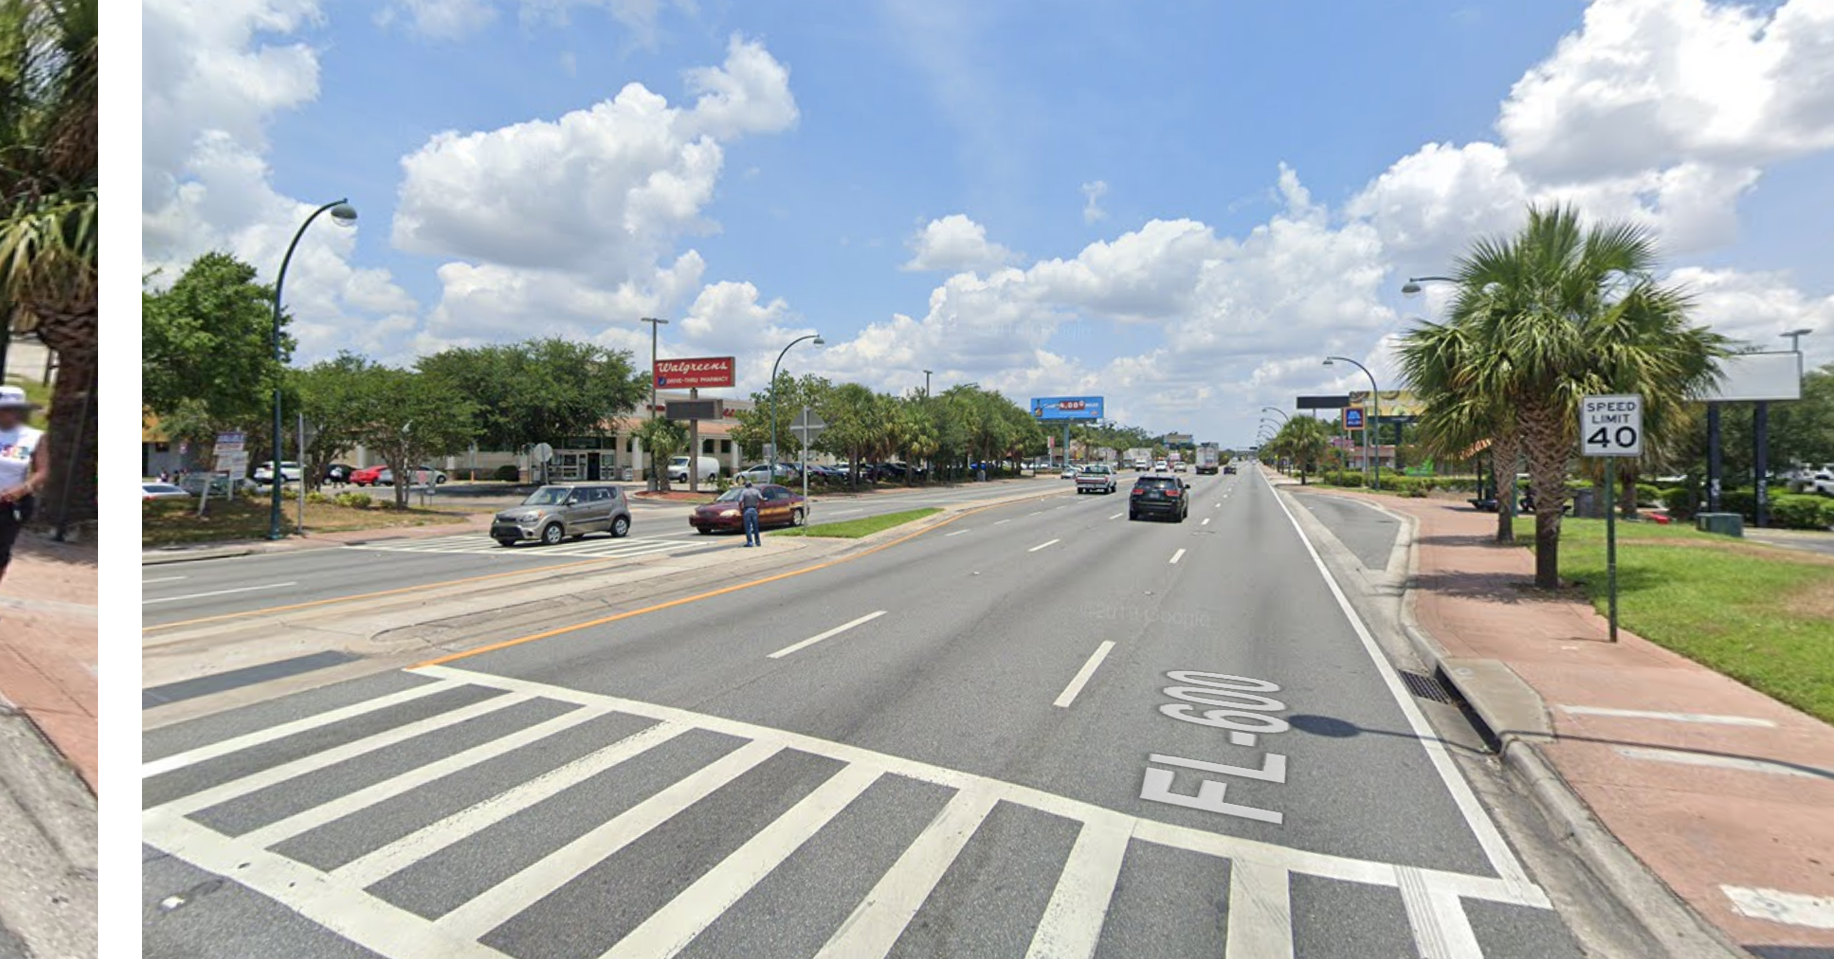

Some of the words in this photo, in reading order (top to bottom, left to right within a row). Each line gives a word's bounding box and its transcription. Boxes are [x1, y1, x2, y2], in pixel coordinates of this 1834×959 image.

[657, 362, 728, 374] Walgreens
[666, 377, 699, 385] DRIVE-THRU
[1587, 402, 1636, 412] SPEED
[1591, 414, 1630, 424] LIMIT
[1587, 426, 1637, 448] 40
